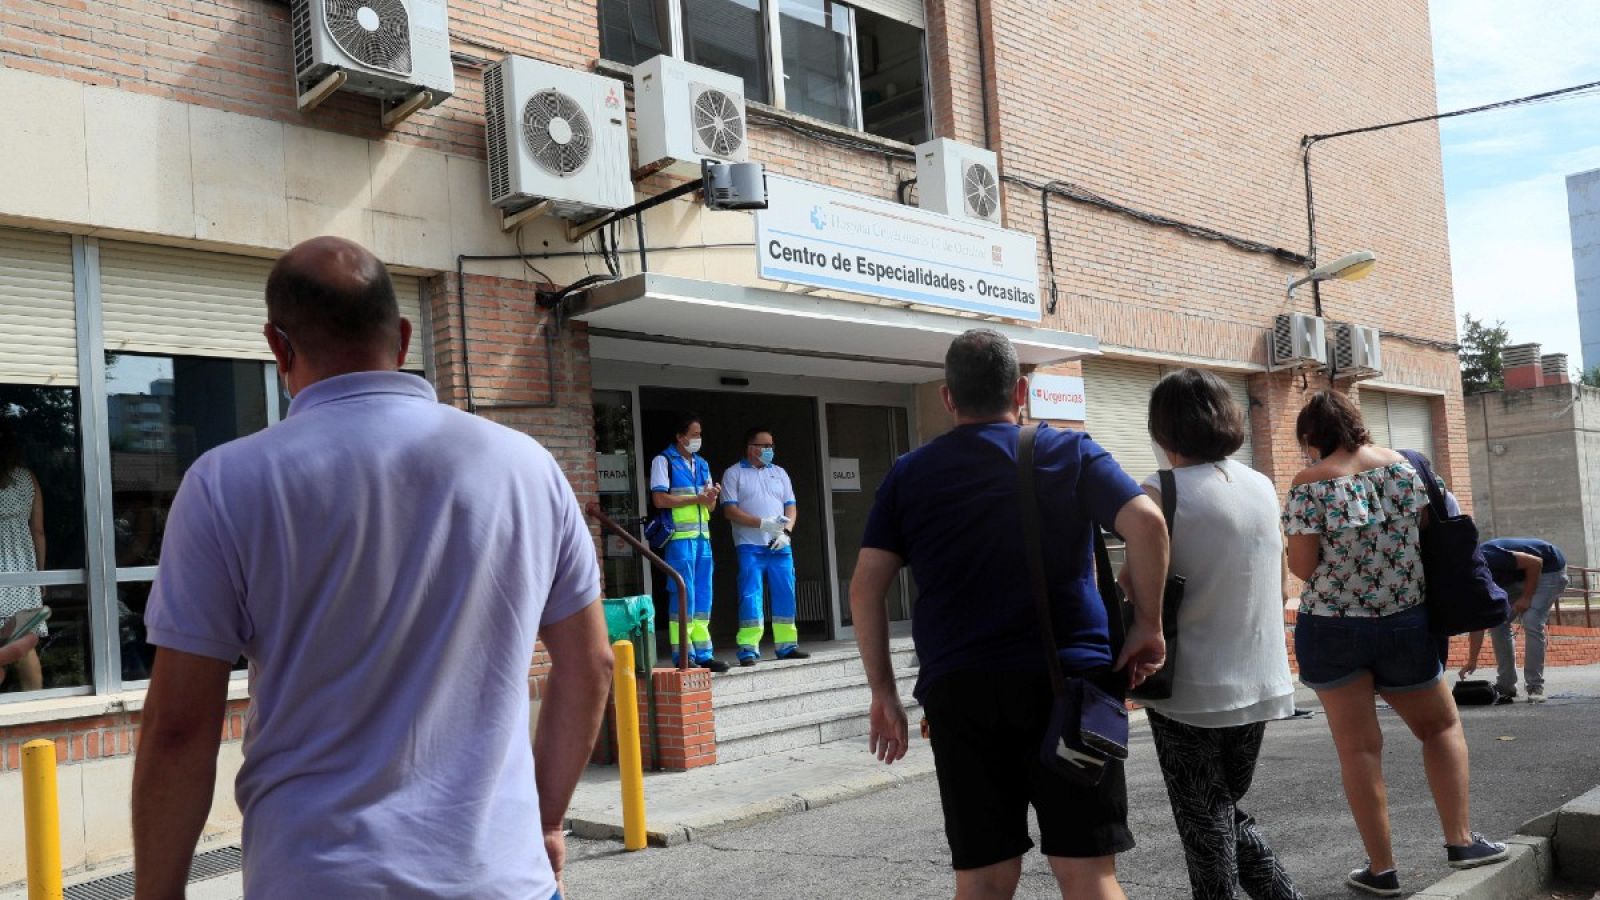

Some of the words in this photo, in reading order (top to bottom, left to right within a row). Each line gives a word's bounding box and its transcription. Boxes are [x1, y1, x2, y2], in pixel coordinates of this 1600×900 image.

[769, 239, 827, 268] Centro
[831, 252, 852, 273] de
[856, 255, 966, 293] Especialidades
[976, 279, 1036, 305] Orcasitas
